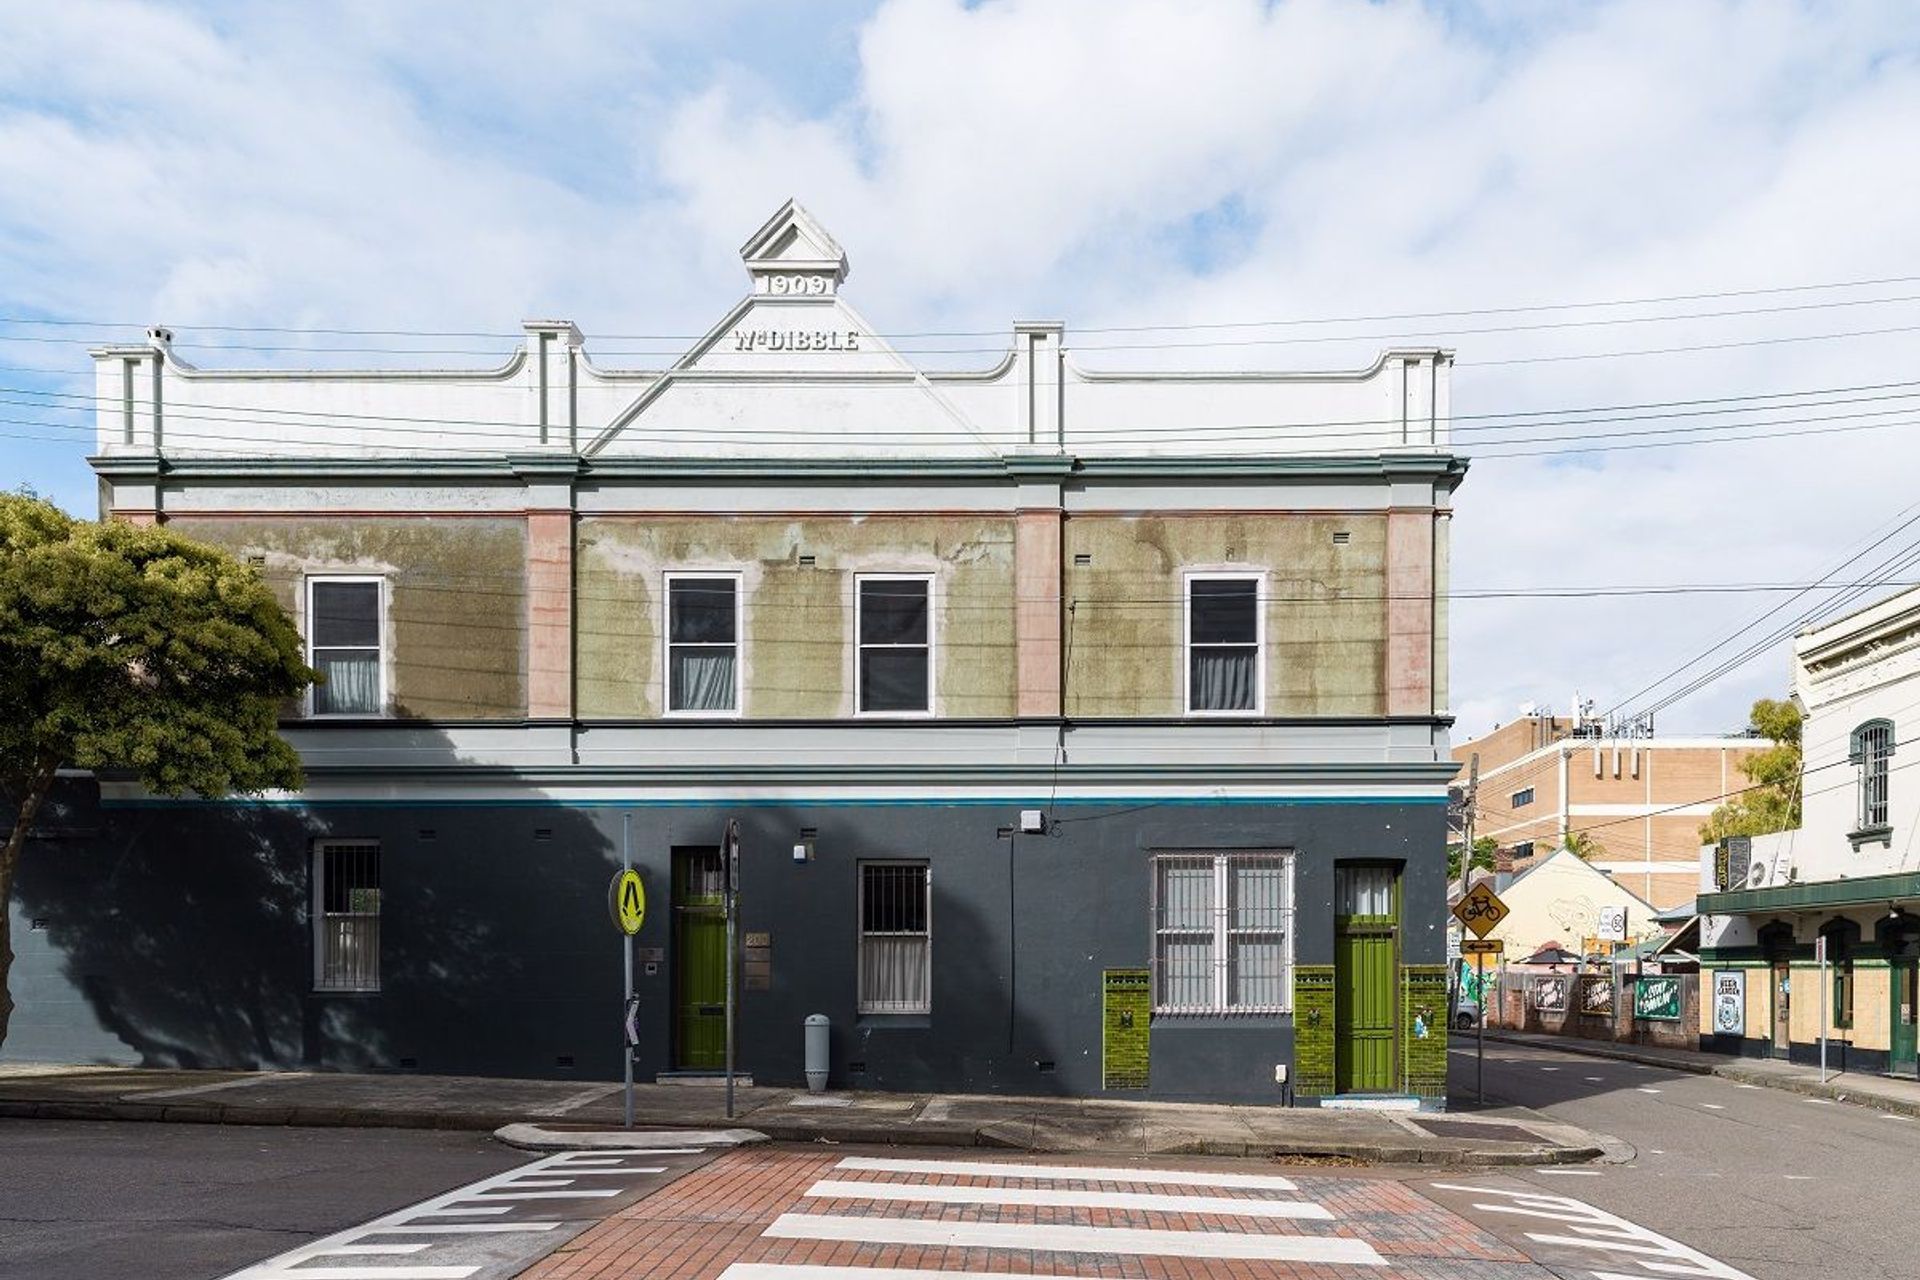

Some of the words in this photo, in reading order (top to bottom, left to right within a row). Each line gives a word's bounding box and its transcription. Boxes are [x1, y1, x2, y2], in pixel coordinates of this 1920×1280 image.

[764, 275, 827, 294] 1909
[768, 330, 859, 351] DIBBLE
[1720, 979, 1737, 989] BEER
